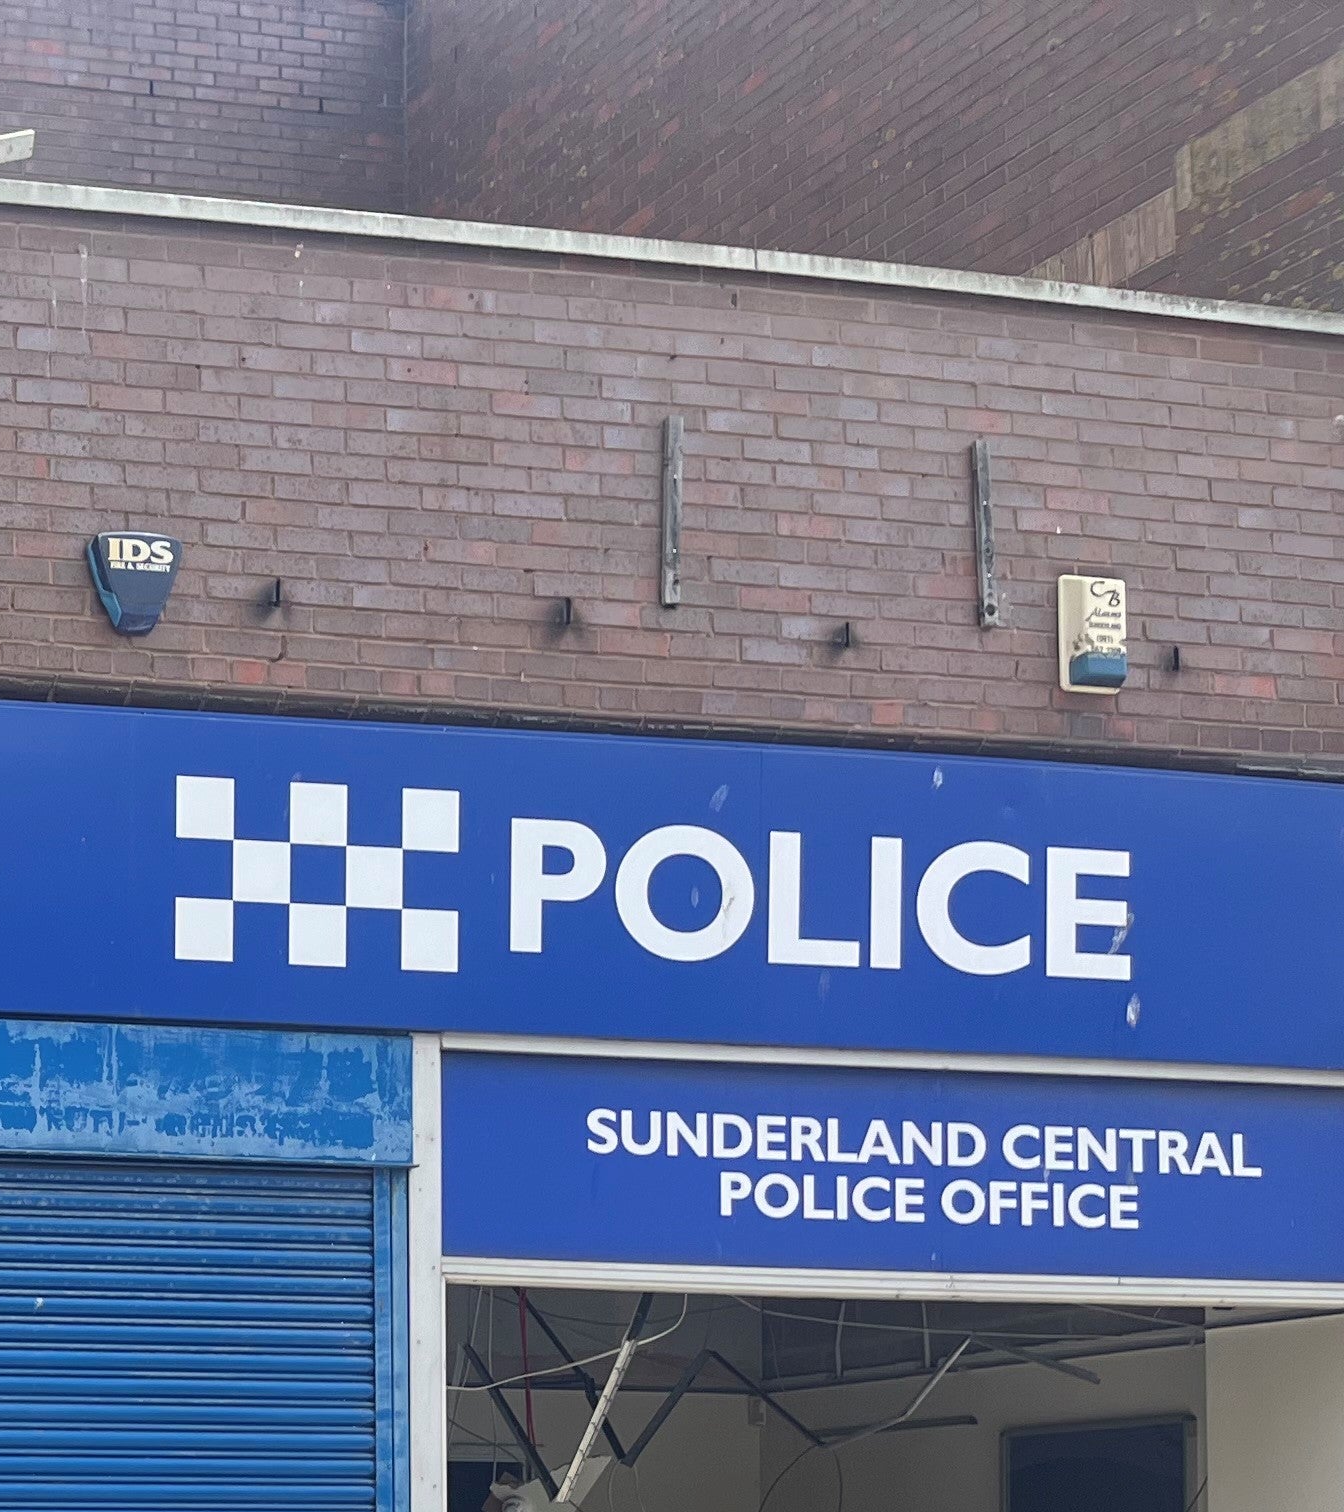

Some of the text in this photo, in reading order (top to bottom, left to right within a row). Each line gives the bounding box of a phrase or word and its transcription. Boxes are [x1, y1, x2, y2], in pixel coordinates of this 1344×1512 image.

[107, 537, 173, 564] IDS
[509, 817, 1132, 981] POLICE
[586, 1108, 1263, 1178] SUNDERLAND CENTRAL
[720, 1171, 1139, 1229] POLICE OFFICE
